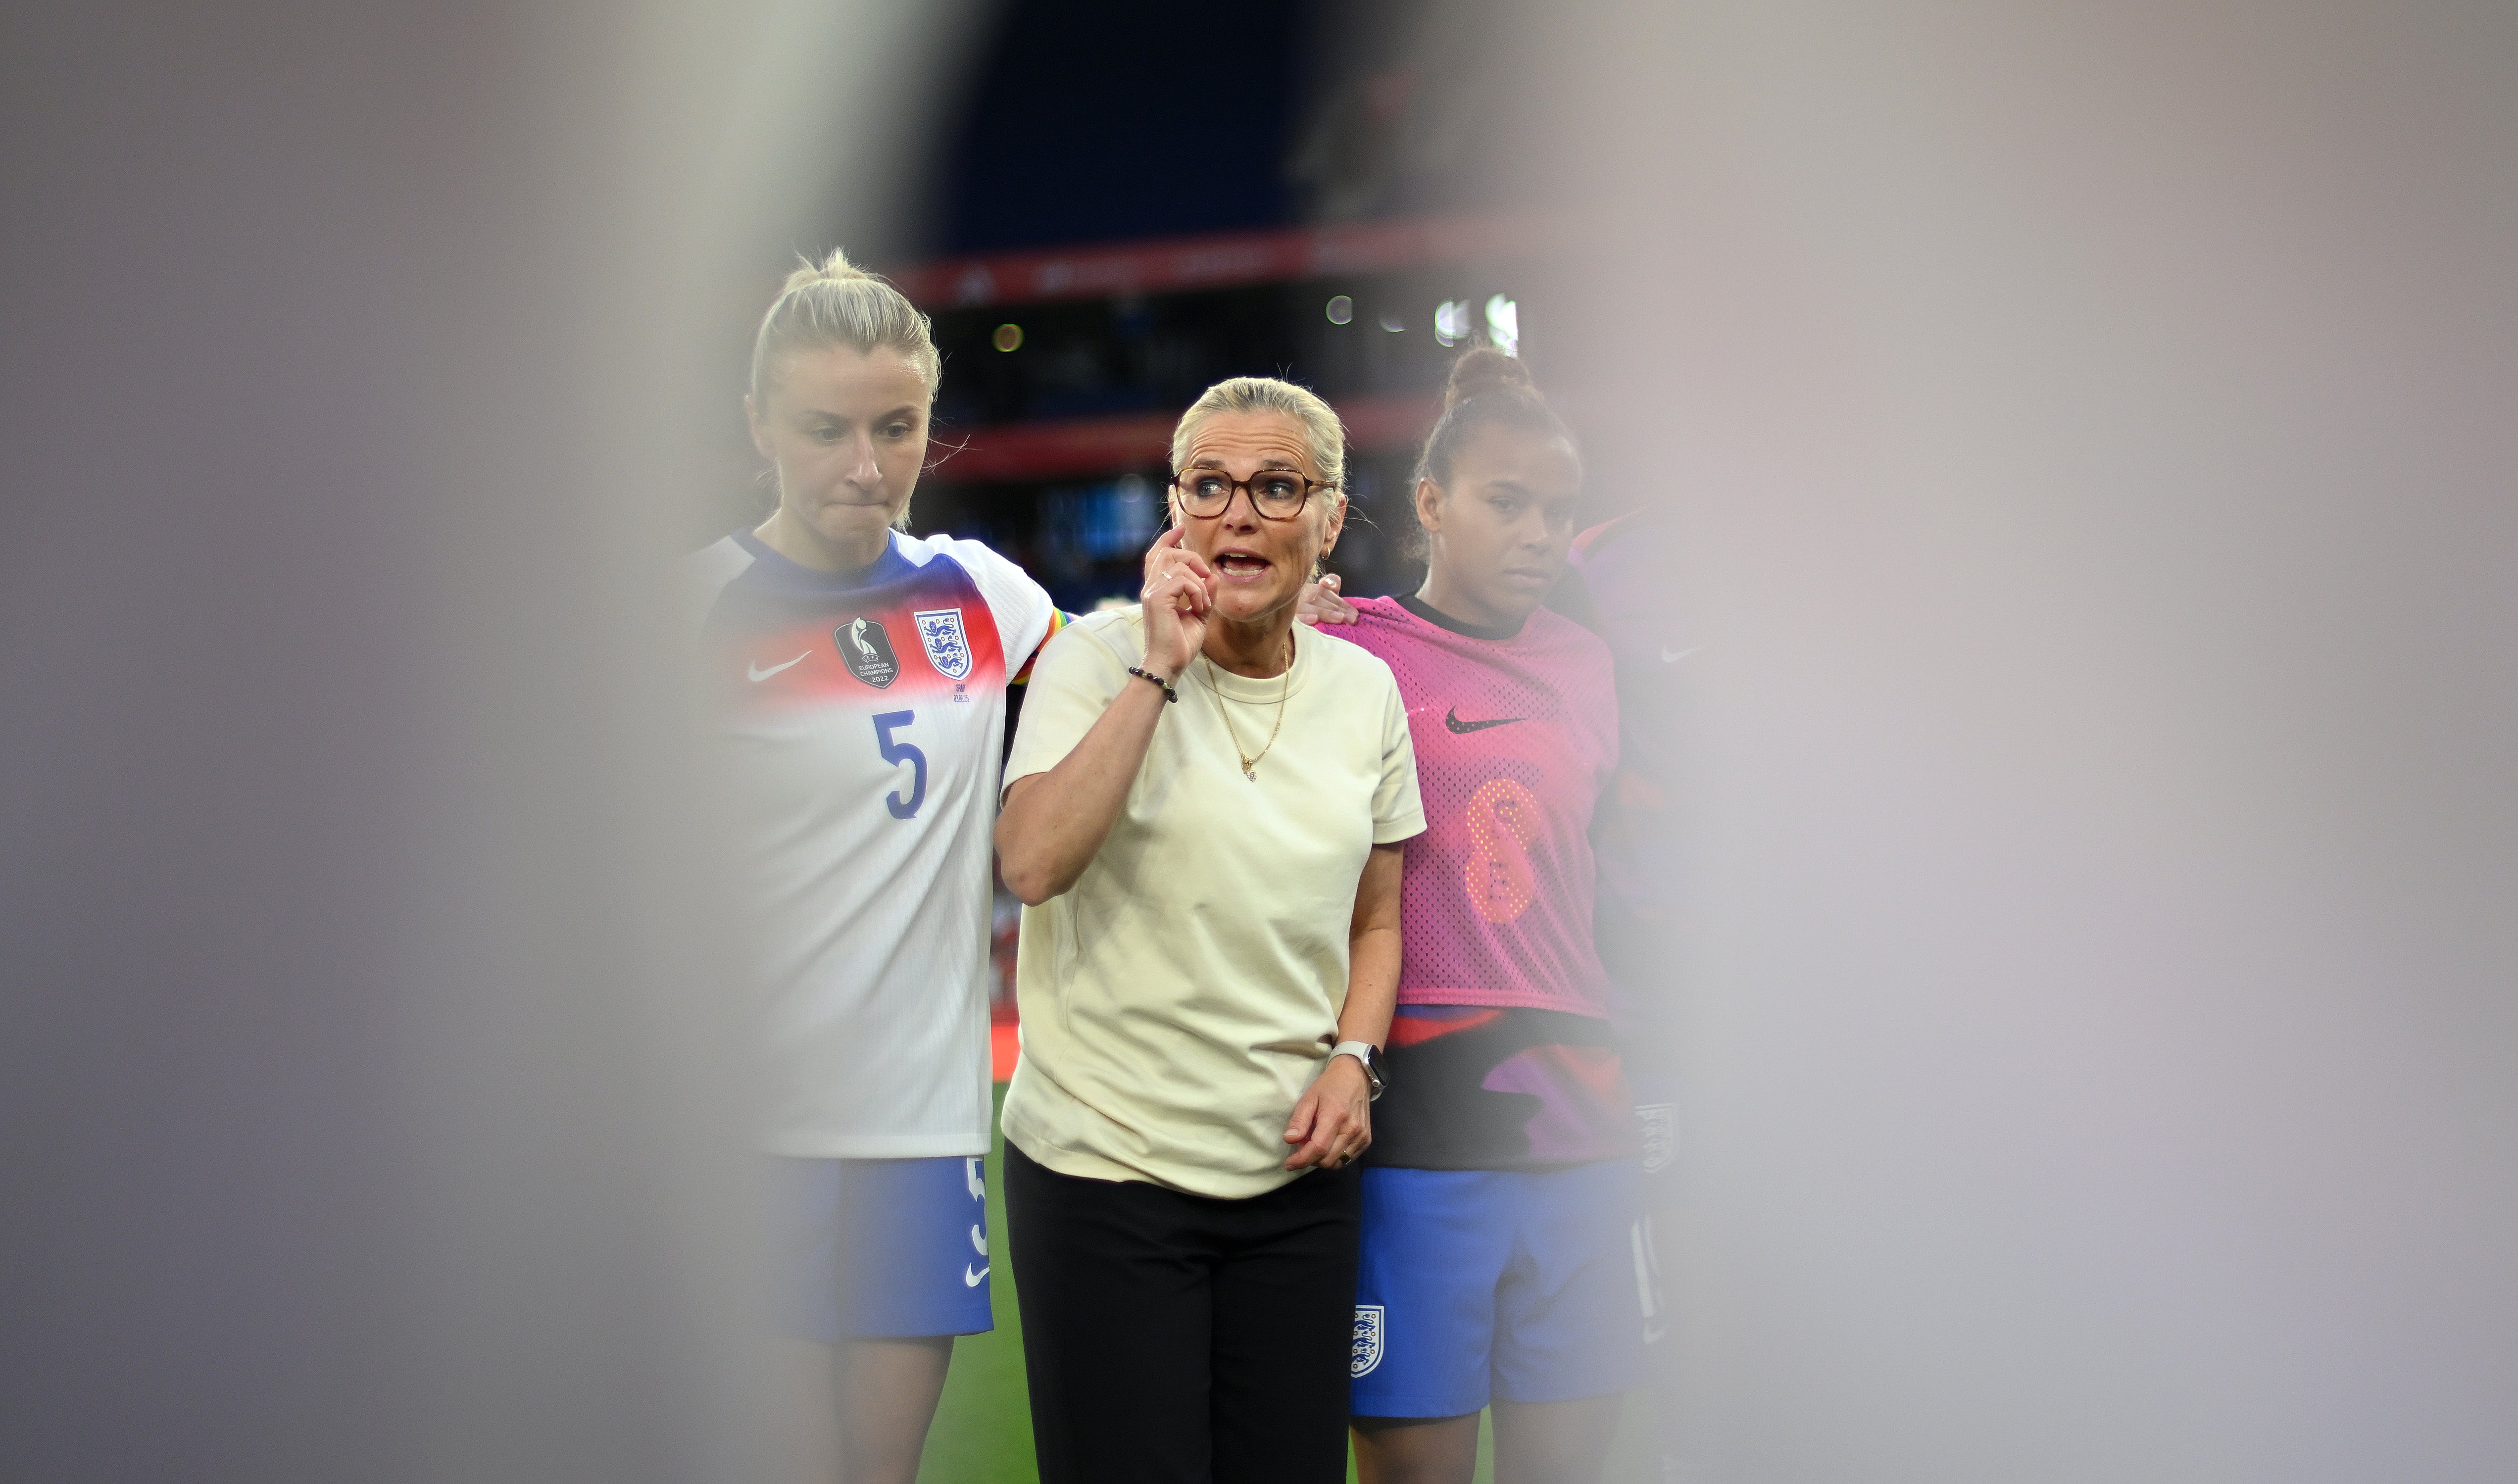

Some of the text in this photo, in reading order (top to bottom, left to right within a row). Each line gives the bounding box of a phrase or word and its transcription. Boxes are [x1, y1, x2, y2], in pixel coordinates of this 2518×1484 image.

[859, 662, 889, 671] EUROPEAN
[860, 668, 893, 676] CHAMPIONS
[872, 709, 928, 820] 5
